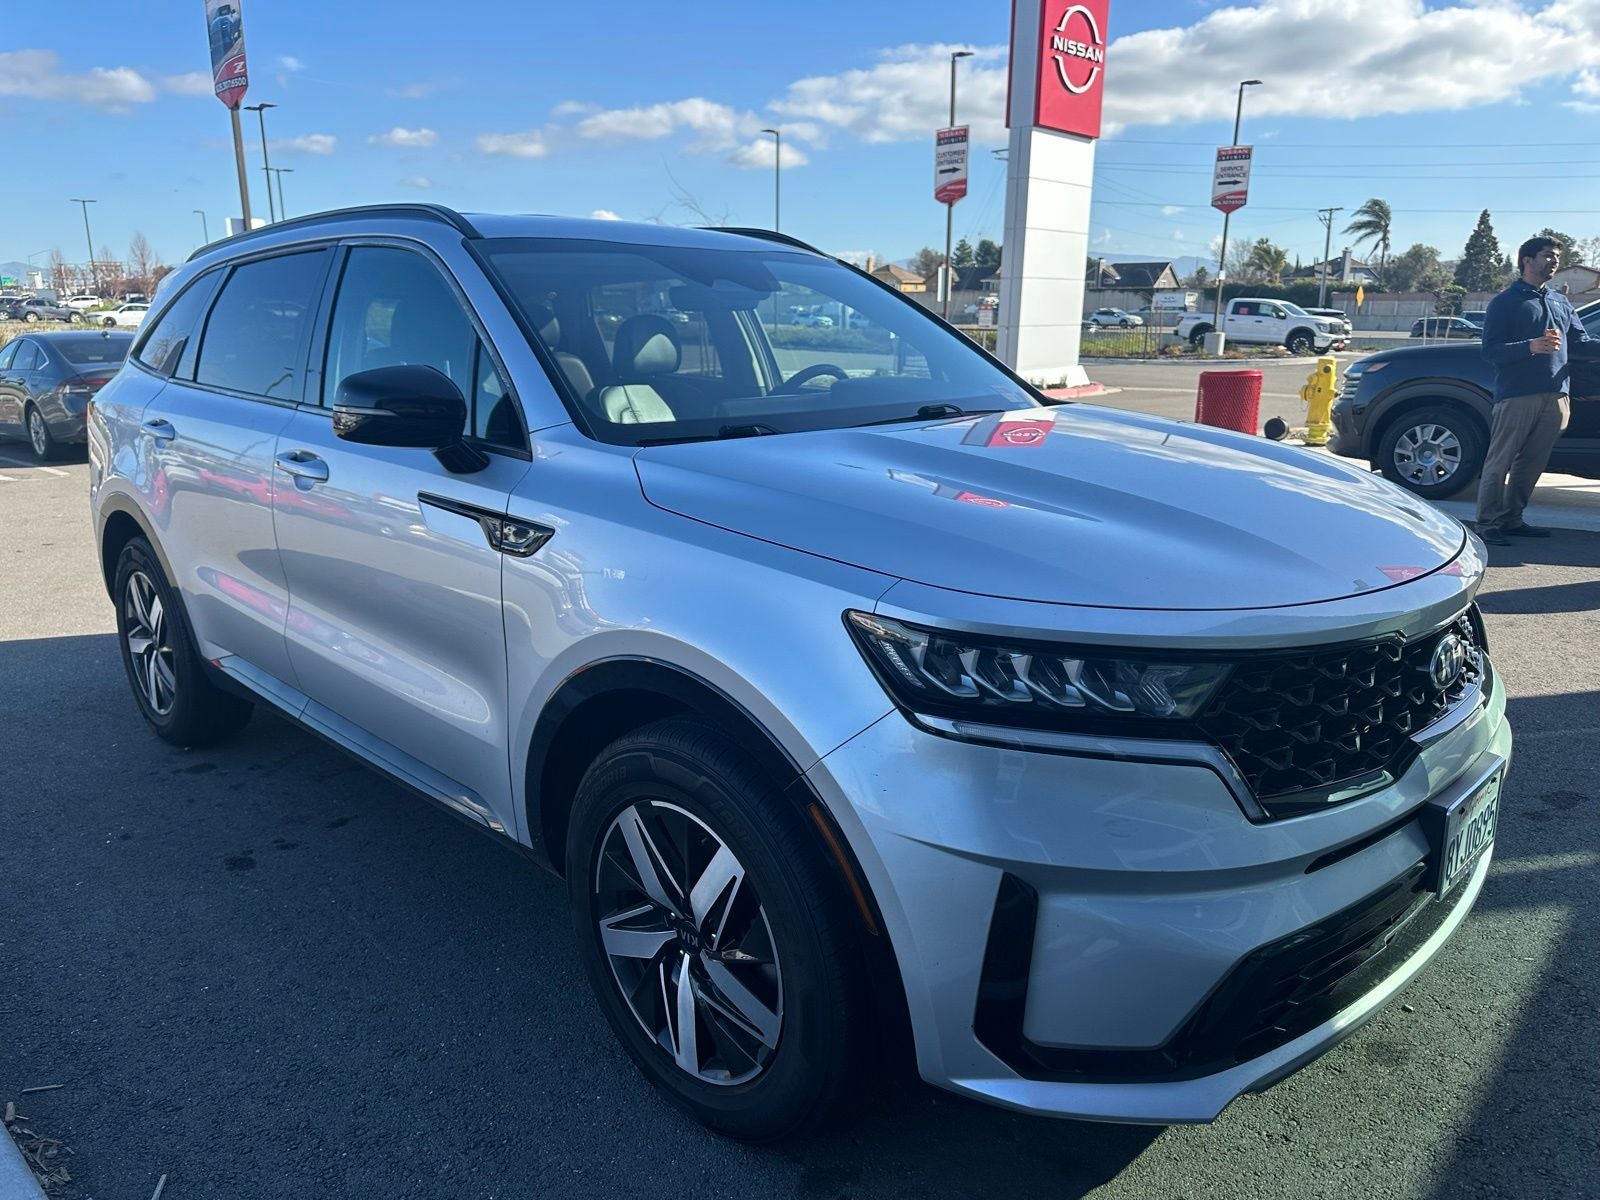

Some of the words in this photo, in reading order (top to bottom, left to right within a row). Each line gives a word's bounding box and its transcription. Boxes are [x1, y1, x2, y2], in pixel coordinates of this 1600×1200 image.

[1053, 35, 1104, 63] NISSAN
[234, 61, 245, 74] Z
[937, 150, 966, 159] CUSTOMER
[937, 158, 965, 167] ENTRANCE
[1216, 172, 1246, 180] ENTRANCE
[680, 929, 699, 948] KIA
